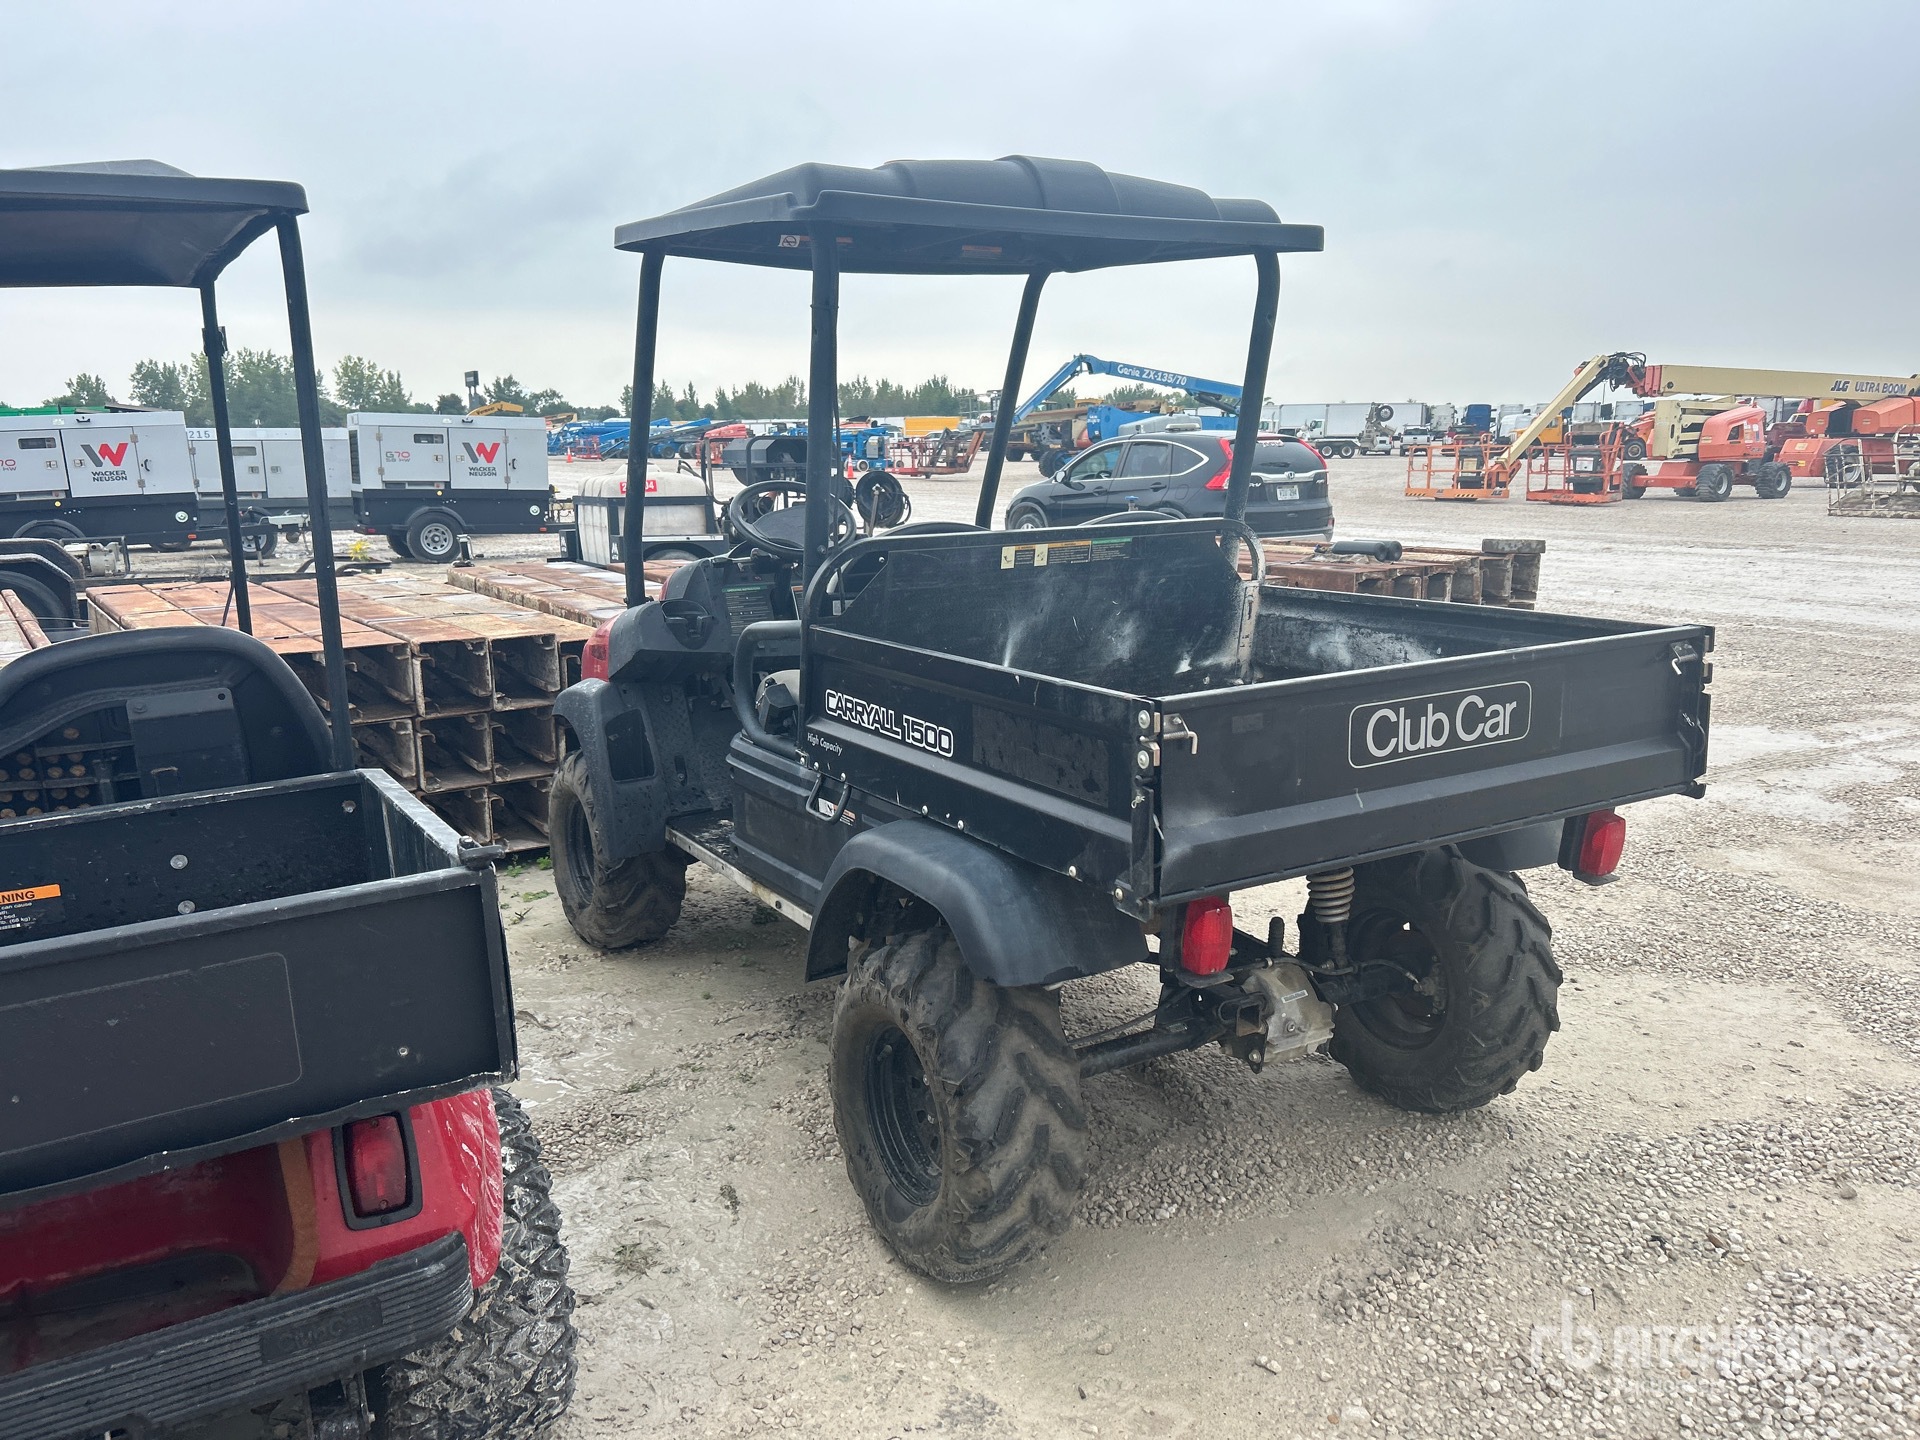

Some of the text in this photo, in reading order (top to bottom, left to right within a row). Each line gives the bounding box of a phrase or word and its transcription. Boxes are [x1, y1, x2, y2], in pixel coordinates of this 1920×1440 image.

[1117, 364, 1188, 386] Genie ZX-135/70
[1830, 380, 1907, 395] JLG ULTRA BOOM
[188, 430, 211, 439] 215
[385, 451, 411, 459] G70
[91, 469, 127, 477] WACKER
[825, 688, 954, 758] CARRYALL 1500
[1366, 694, 1517, 758] Club Car
[807, 732, 843, 757] High Capacity
[0, 891, 35, 903] NING
